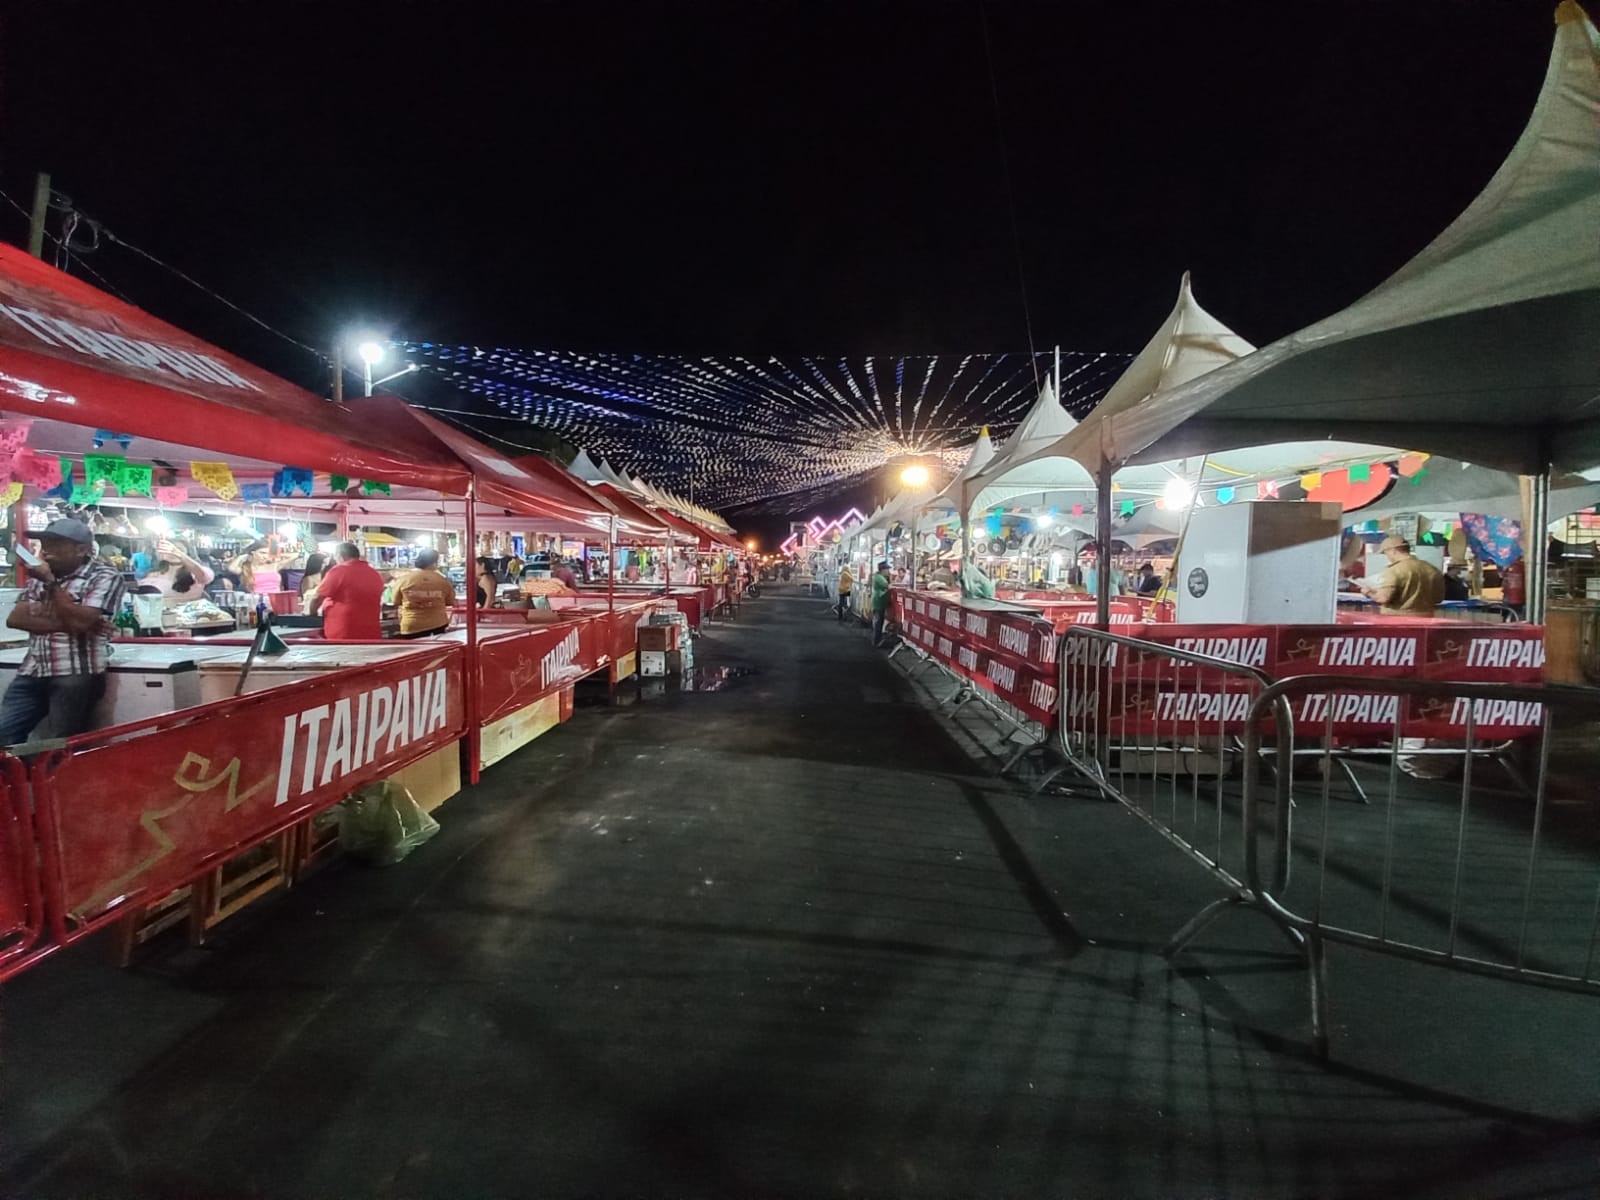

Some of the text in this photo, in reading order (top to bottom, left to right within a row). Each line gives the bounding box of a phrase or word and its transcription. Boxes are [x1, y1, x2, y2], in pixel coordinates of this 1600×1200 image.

[1076, 611, 1134, 625] ITAAVA
[998, 623, 1029, 658] ITAIPAVA
[1169, 637, 1268, 667] ITAIPAVA
[1318, 637, 1417, 667] ITAIPAVA
[986, 659, 1016, 694] ITAIPAVA
[1152, 692, 1250, 721] ITAIPAVA
[1299, 693, 1399, 724] ITAIPAVA
[1449, 696, 1543, 727] ITAIPAVA
[274, 668, 447, 808] ITAIPAVA
